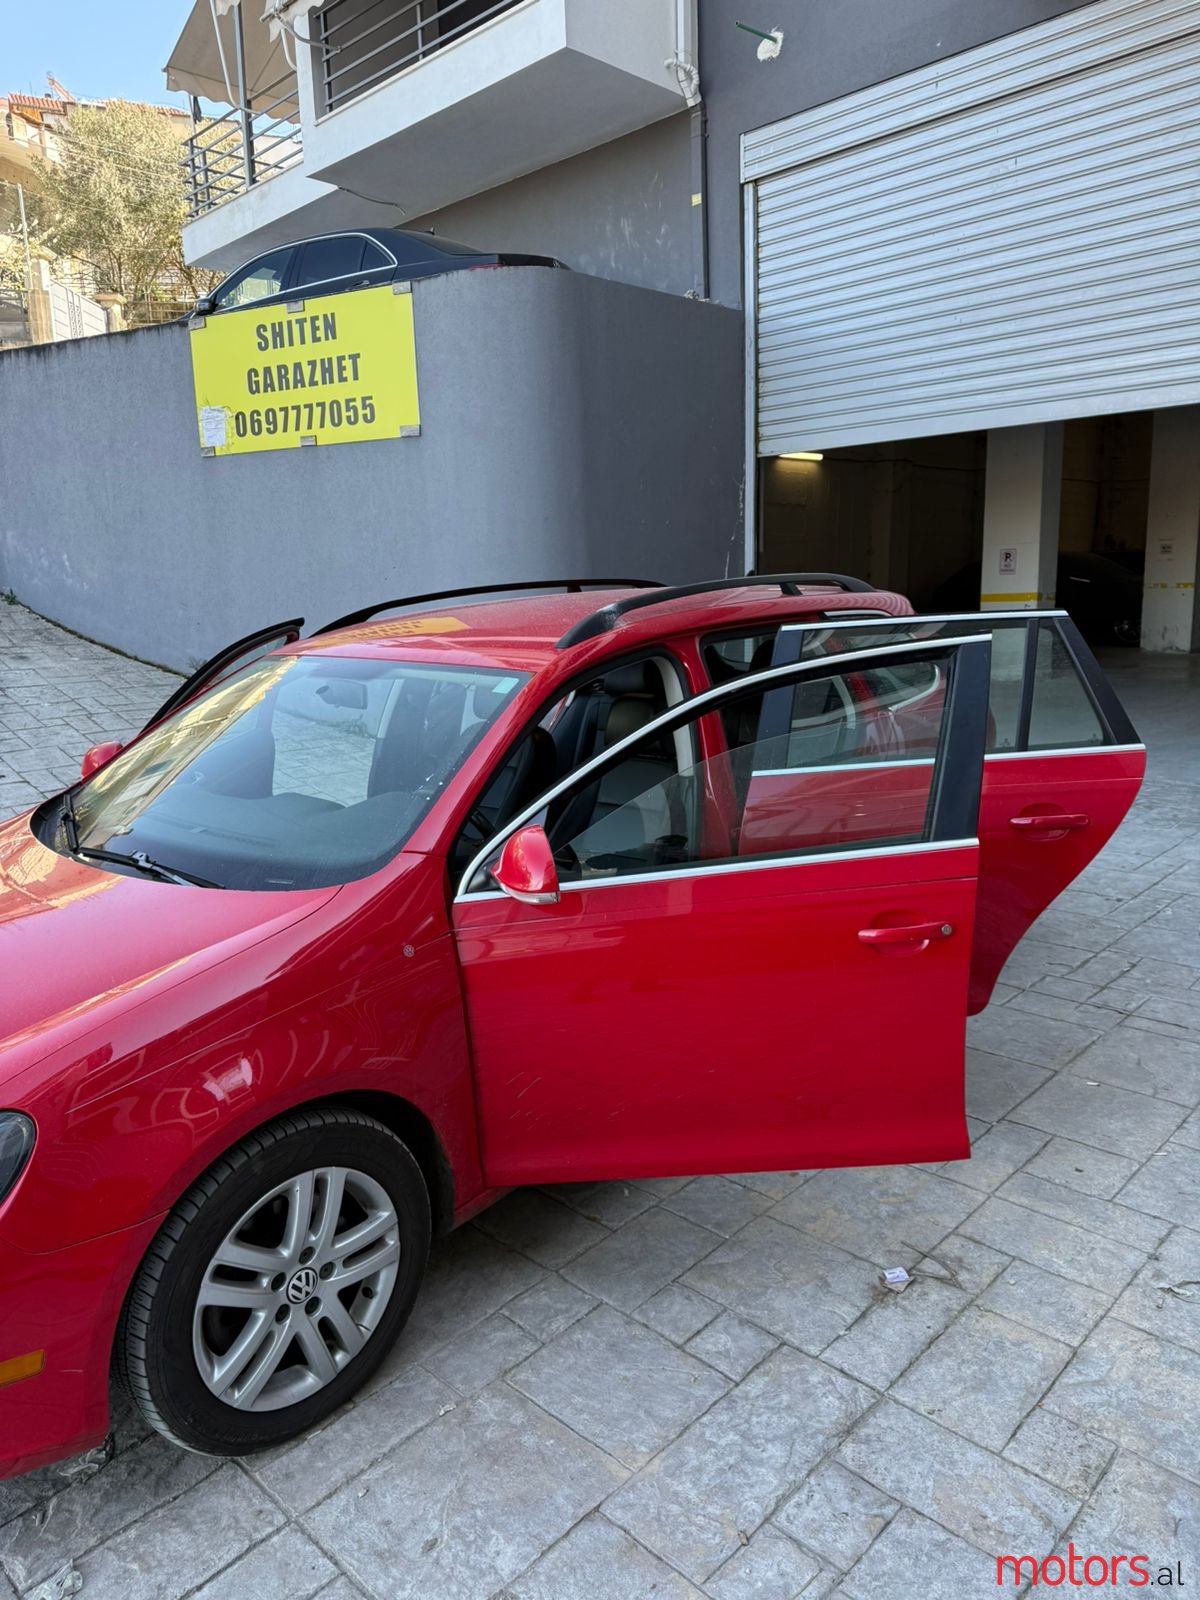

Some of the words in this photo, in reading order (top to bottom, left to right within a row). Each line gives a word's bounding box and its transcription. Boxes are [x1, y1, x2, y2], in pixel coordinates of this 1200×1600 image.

[256, 312, 337, 351] SHITEN
[247, 353, 361, 395] GARAZHET
[234, 396, 376, 438] 0697777055
